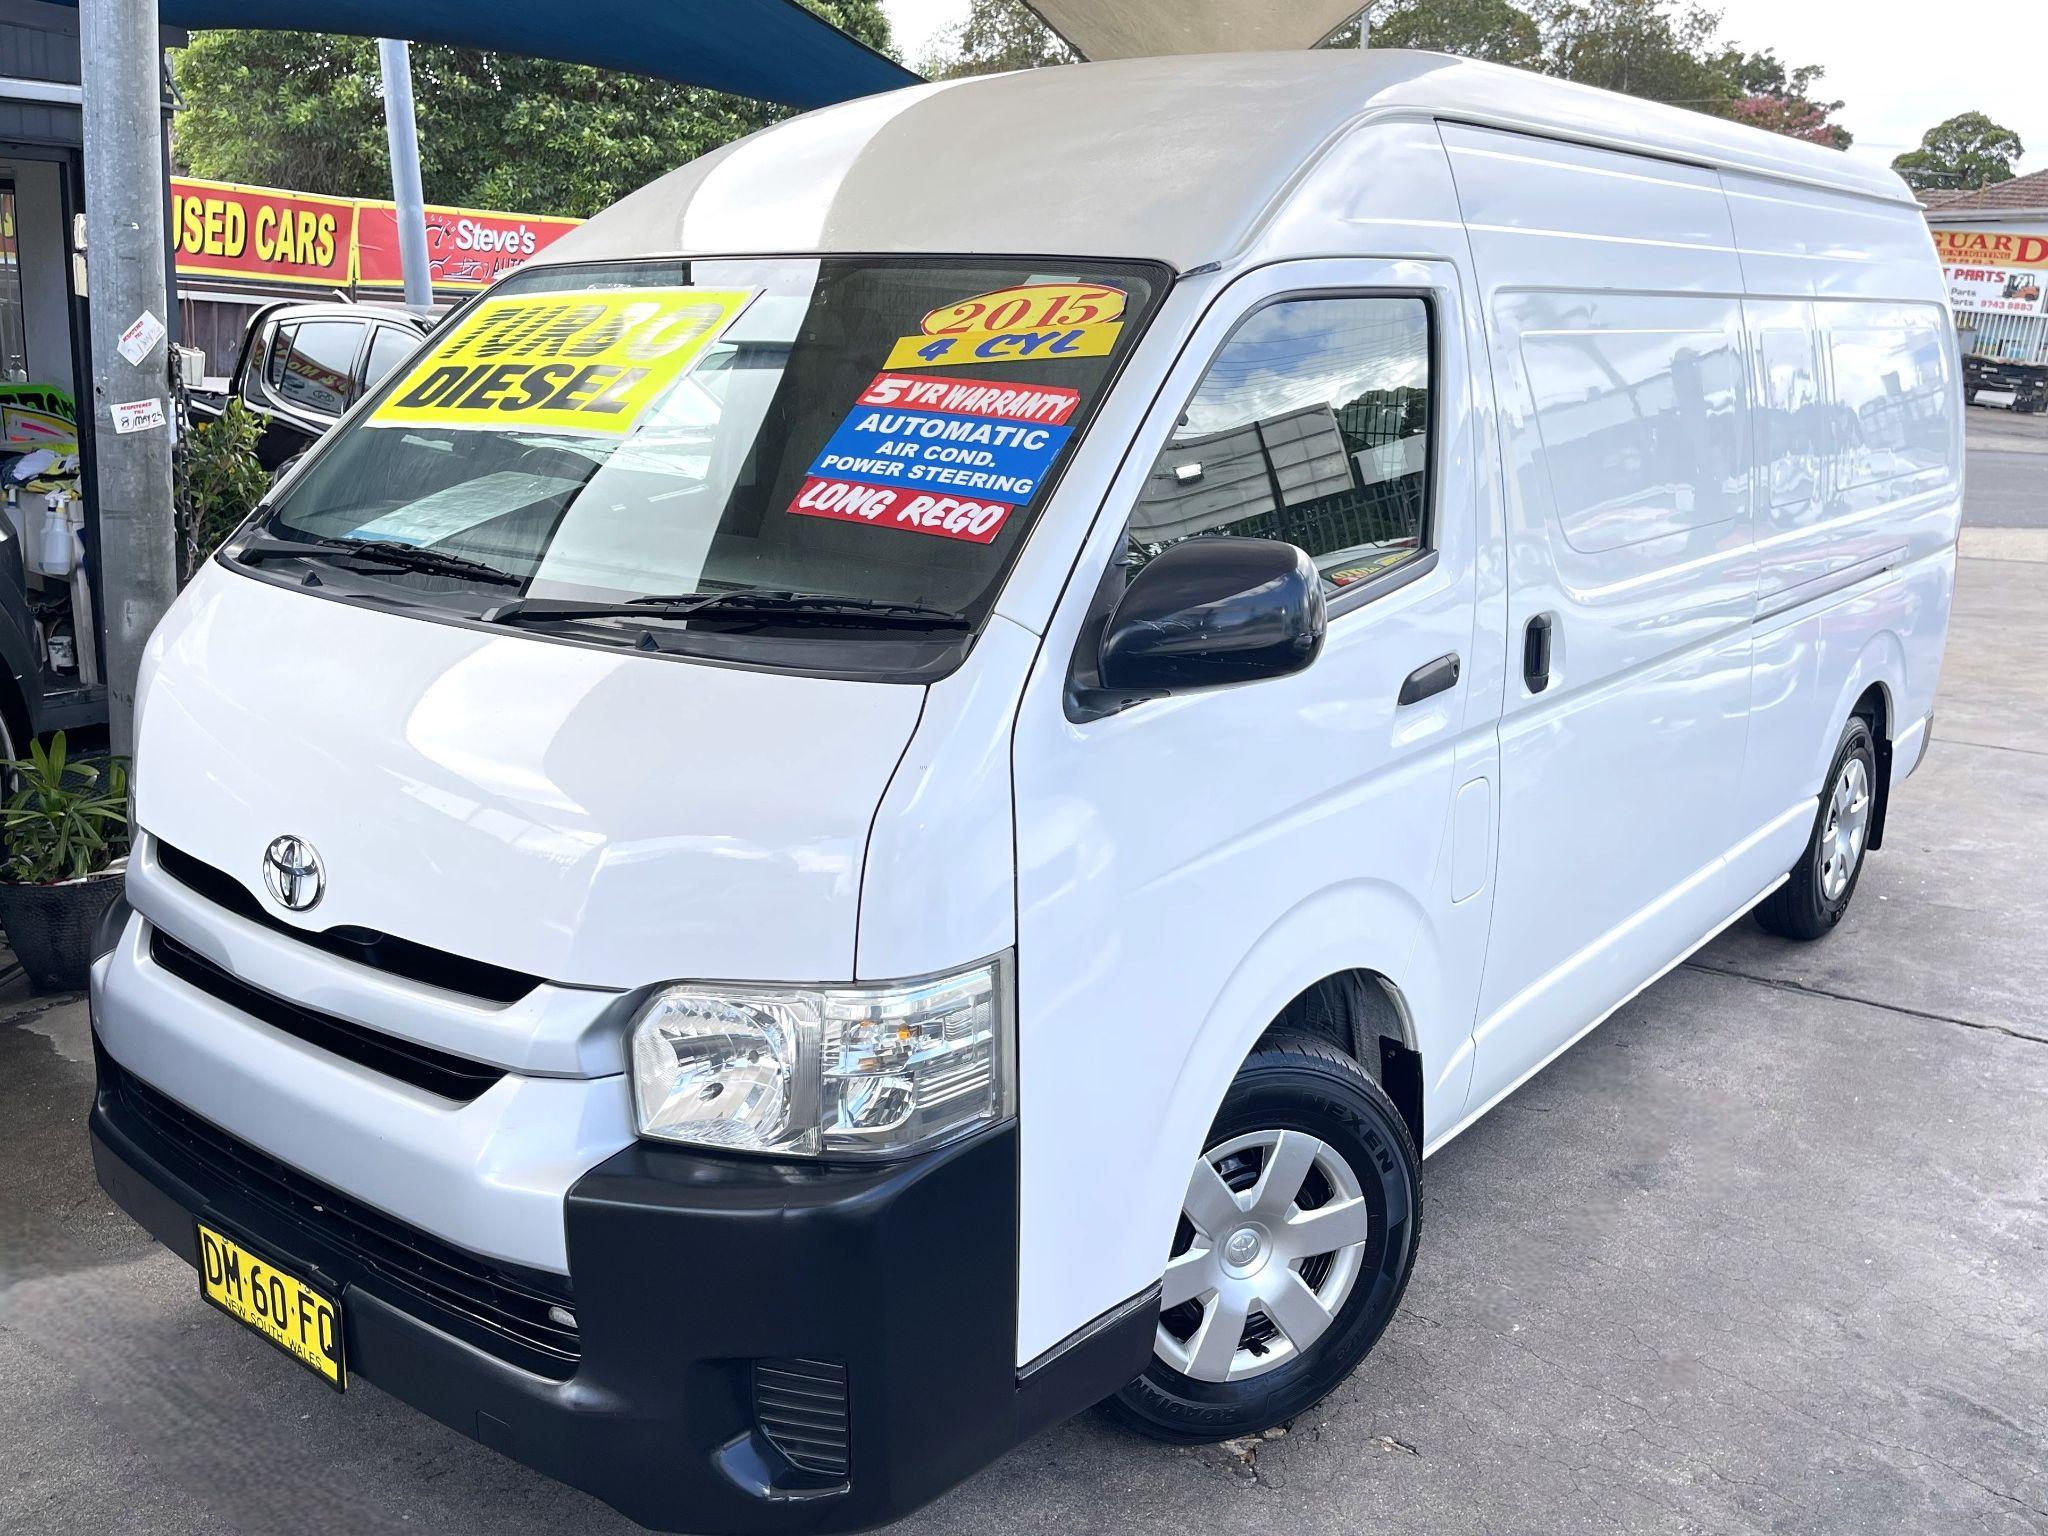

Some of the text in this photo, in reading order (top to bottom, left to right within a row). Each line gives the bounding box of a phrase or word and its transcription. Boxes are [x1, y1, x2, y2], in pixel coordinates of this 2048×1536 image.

[255, 205, 337, 267] CARS
[455, 219, 536, 255] Steve's
[1954, 269, 2006, 283] PARTS
[439, 303, 724, 360] TURBO
[936, 291, 1111, 335] 2015
[917, 329, 1085, 361] 4 CYL
[394, 363, 652, 414] DIESEL
[863, 379, 1077, 421] 5 YR WARRANTY
[855, 413, 1050, 450] AUTOMATIC
[820, 455, 1034, 495] POWER STEERING
[875, 441, 996, 468] AIR COND.
[799, 482, 1005, 536] LONG REGO
[224, 1295, 323, 1371] NEW SOUTH WALES
